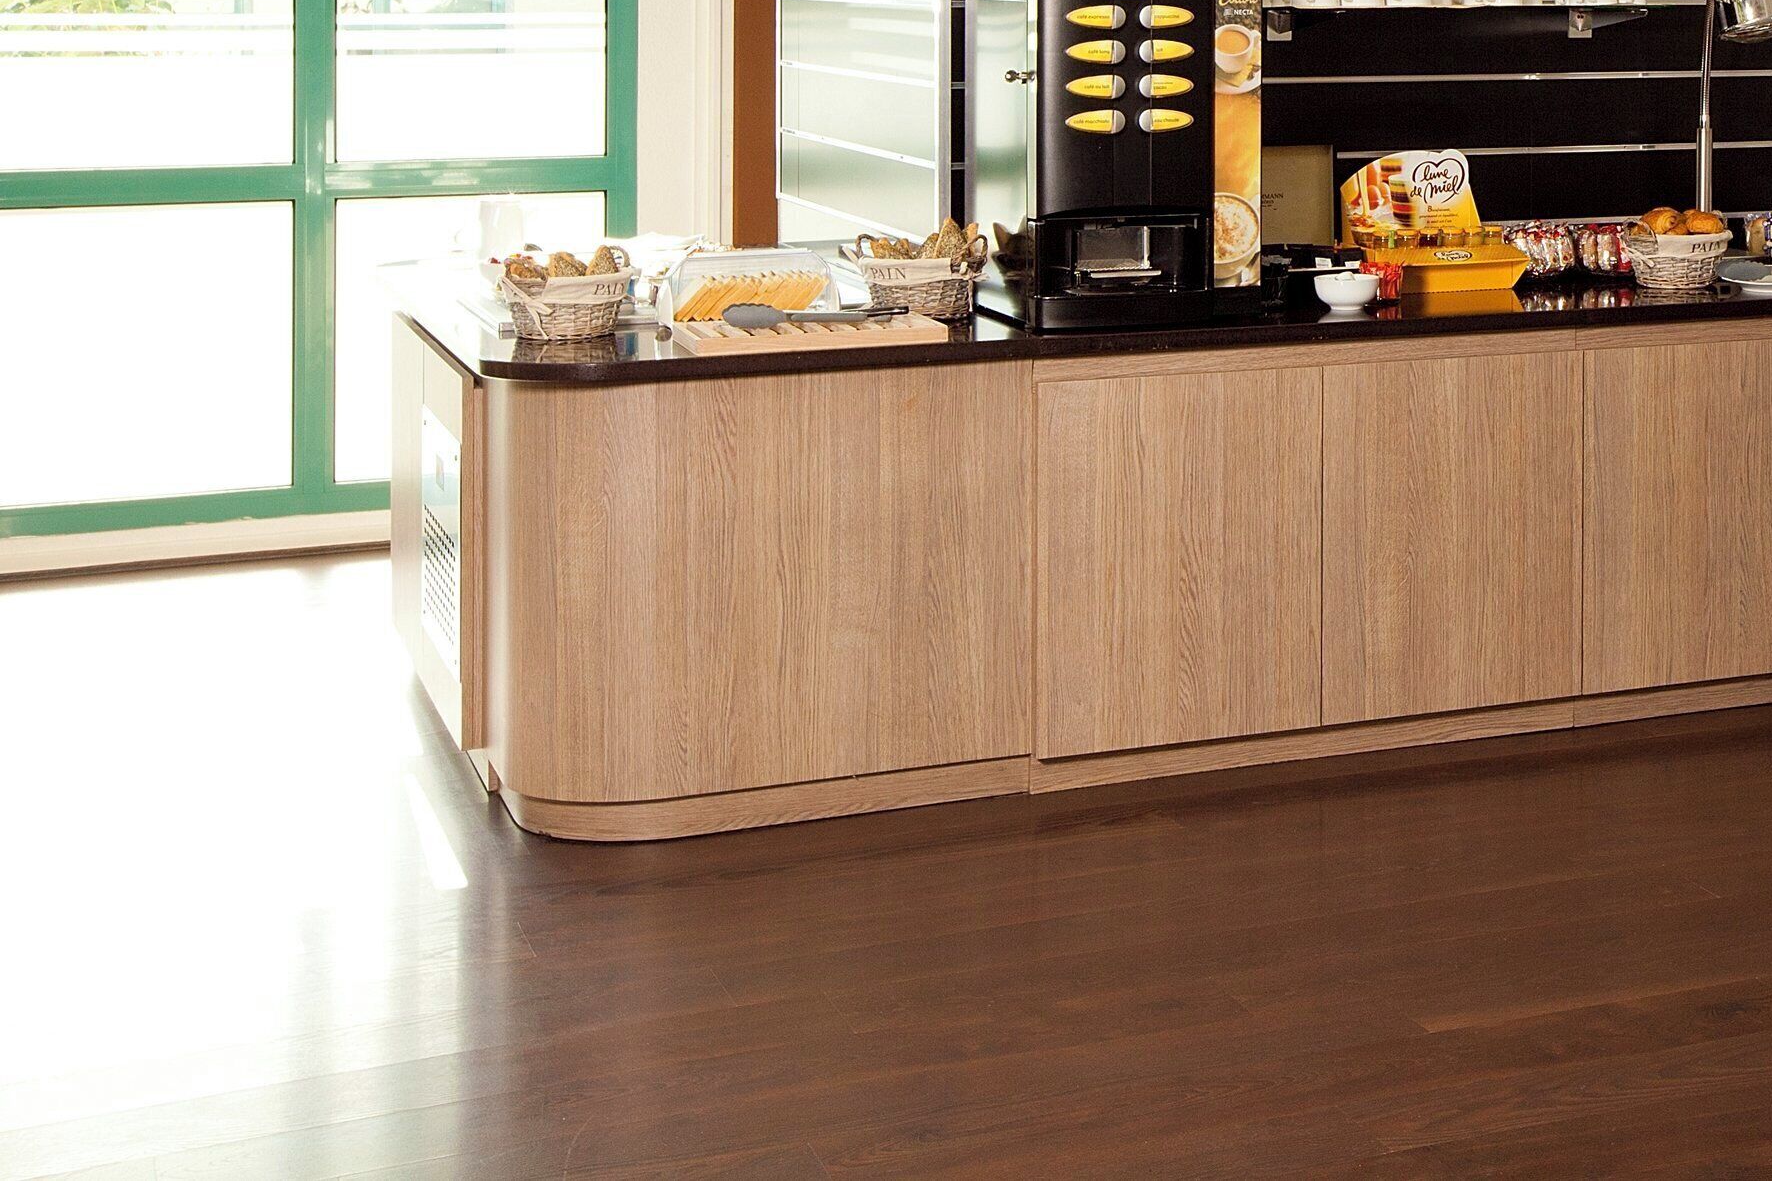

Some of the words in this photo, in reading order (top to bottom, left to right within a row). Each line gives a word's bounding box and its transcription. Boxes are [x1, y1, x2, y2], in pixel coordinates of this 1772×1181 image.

[1420, 165, 1452, 182] lune
[1410, 185, 1422, 198] de
[1690, 240, 1723, 254] PAIN
[870, 267, 907, 280] PAIN
